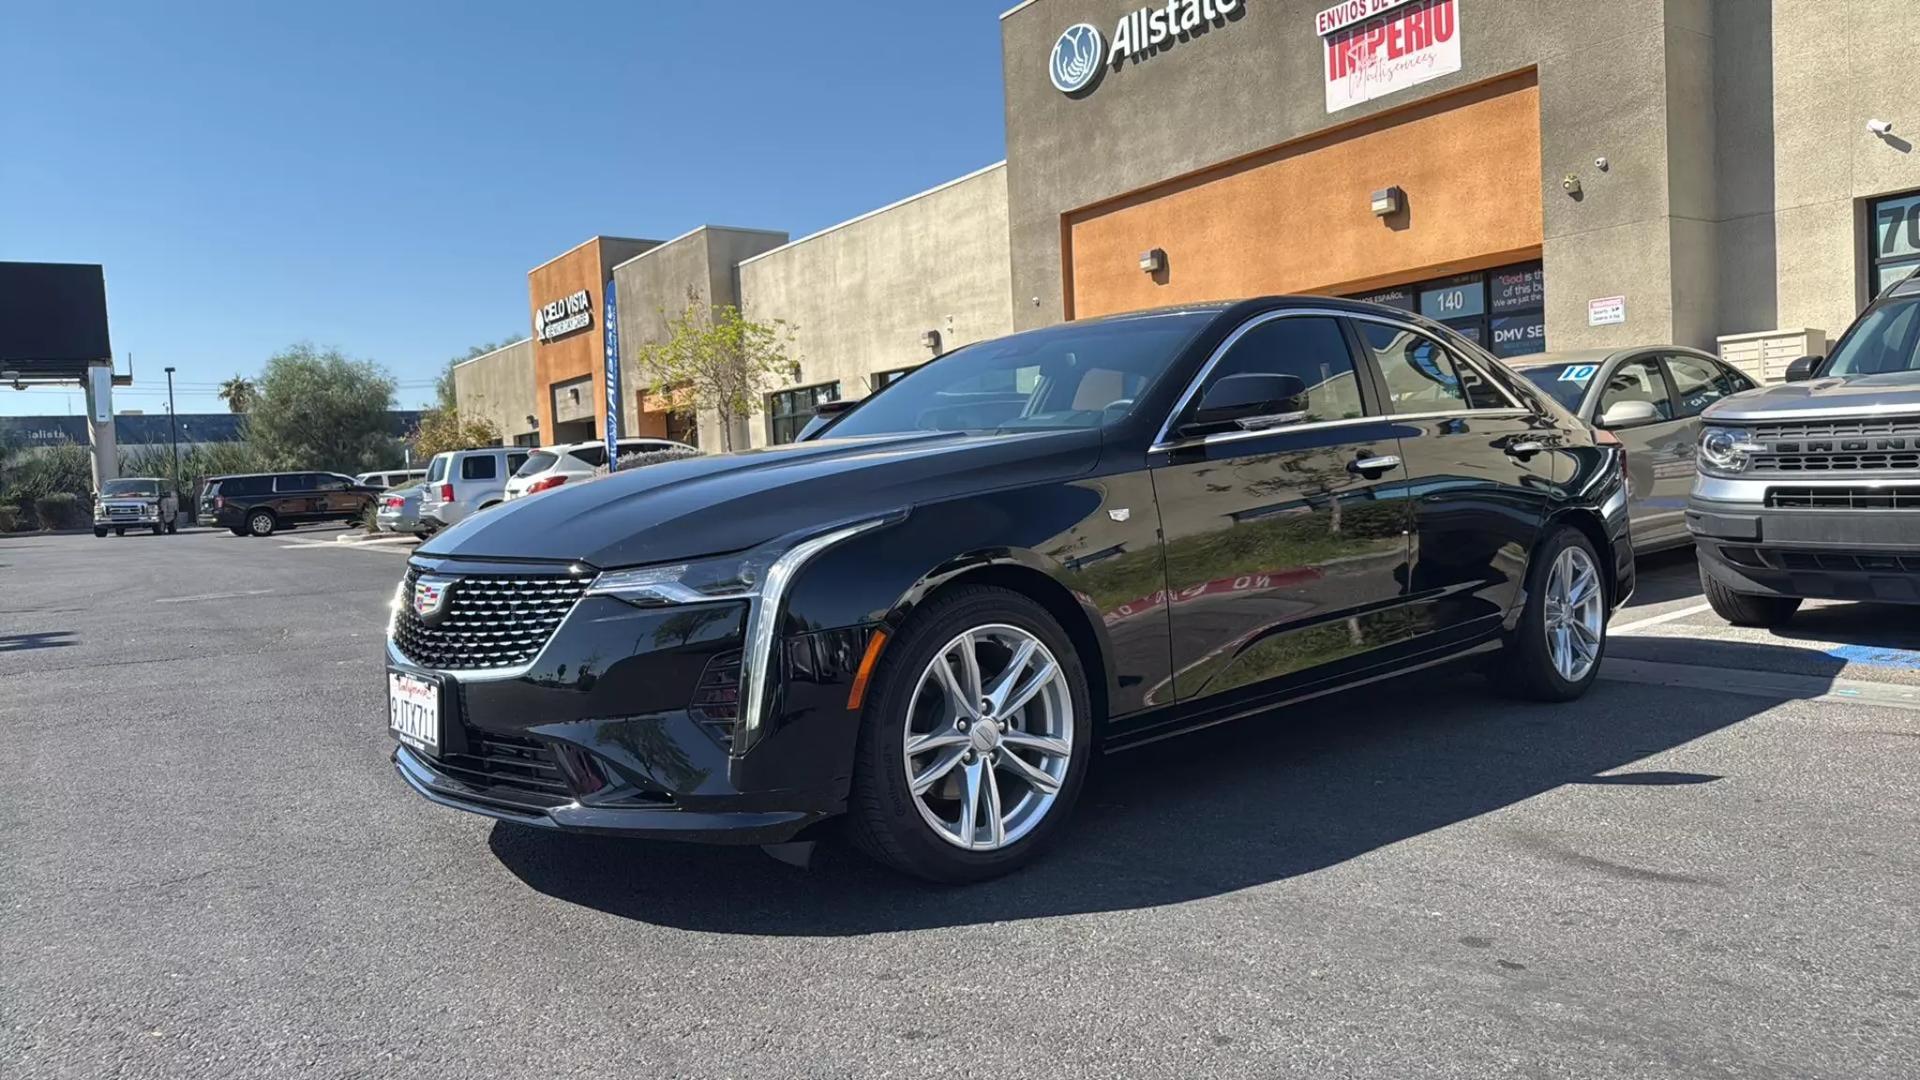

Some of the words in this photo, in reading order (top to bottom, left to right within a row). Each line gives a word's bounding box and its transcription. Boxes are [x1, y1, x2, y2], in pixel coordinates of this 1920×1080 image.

[1319, 0, 1367, 32] ENVIOS
[1503, 285, 1513, 298] of
[1532, 281, 1544, 293] bu
[565, 288, 589, 315] VISTA
[1436, 290, 1464, 312] 140
[1494, 327, 1524, 343] DMV
[1526, 324, 1544, 339] SE
[1562, 366, 1594, 379] 10
[391, 696, 436, 743] 9JTX711
